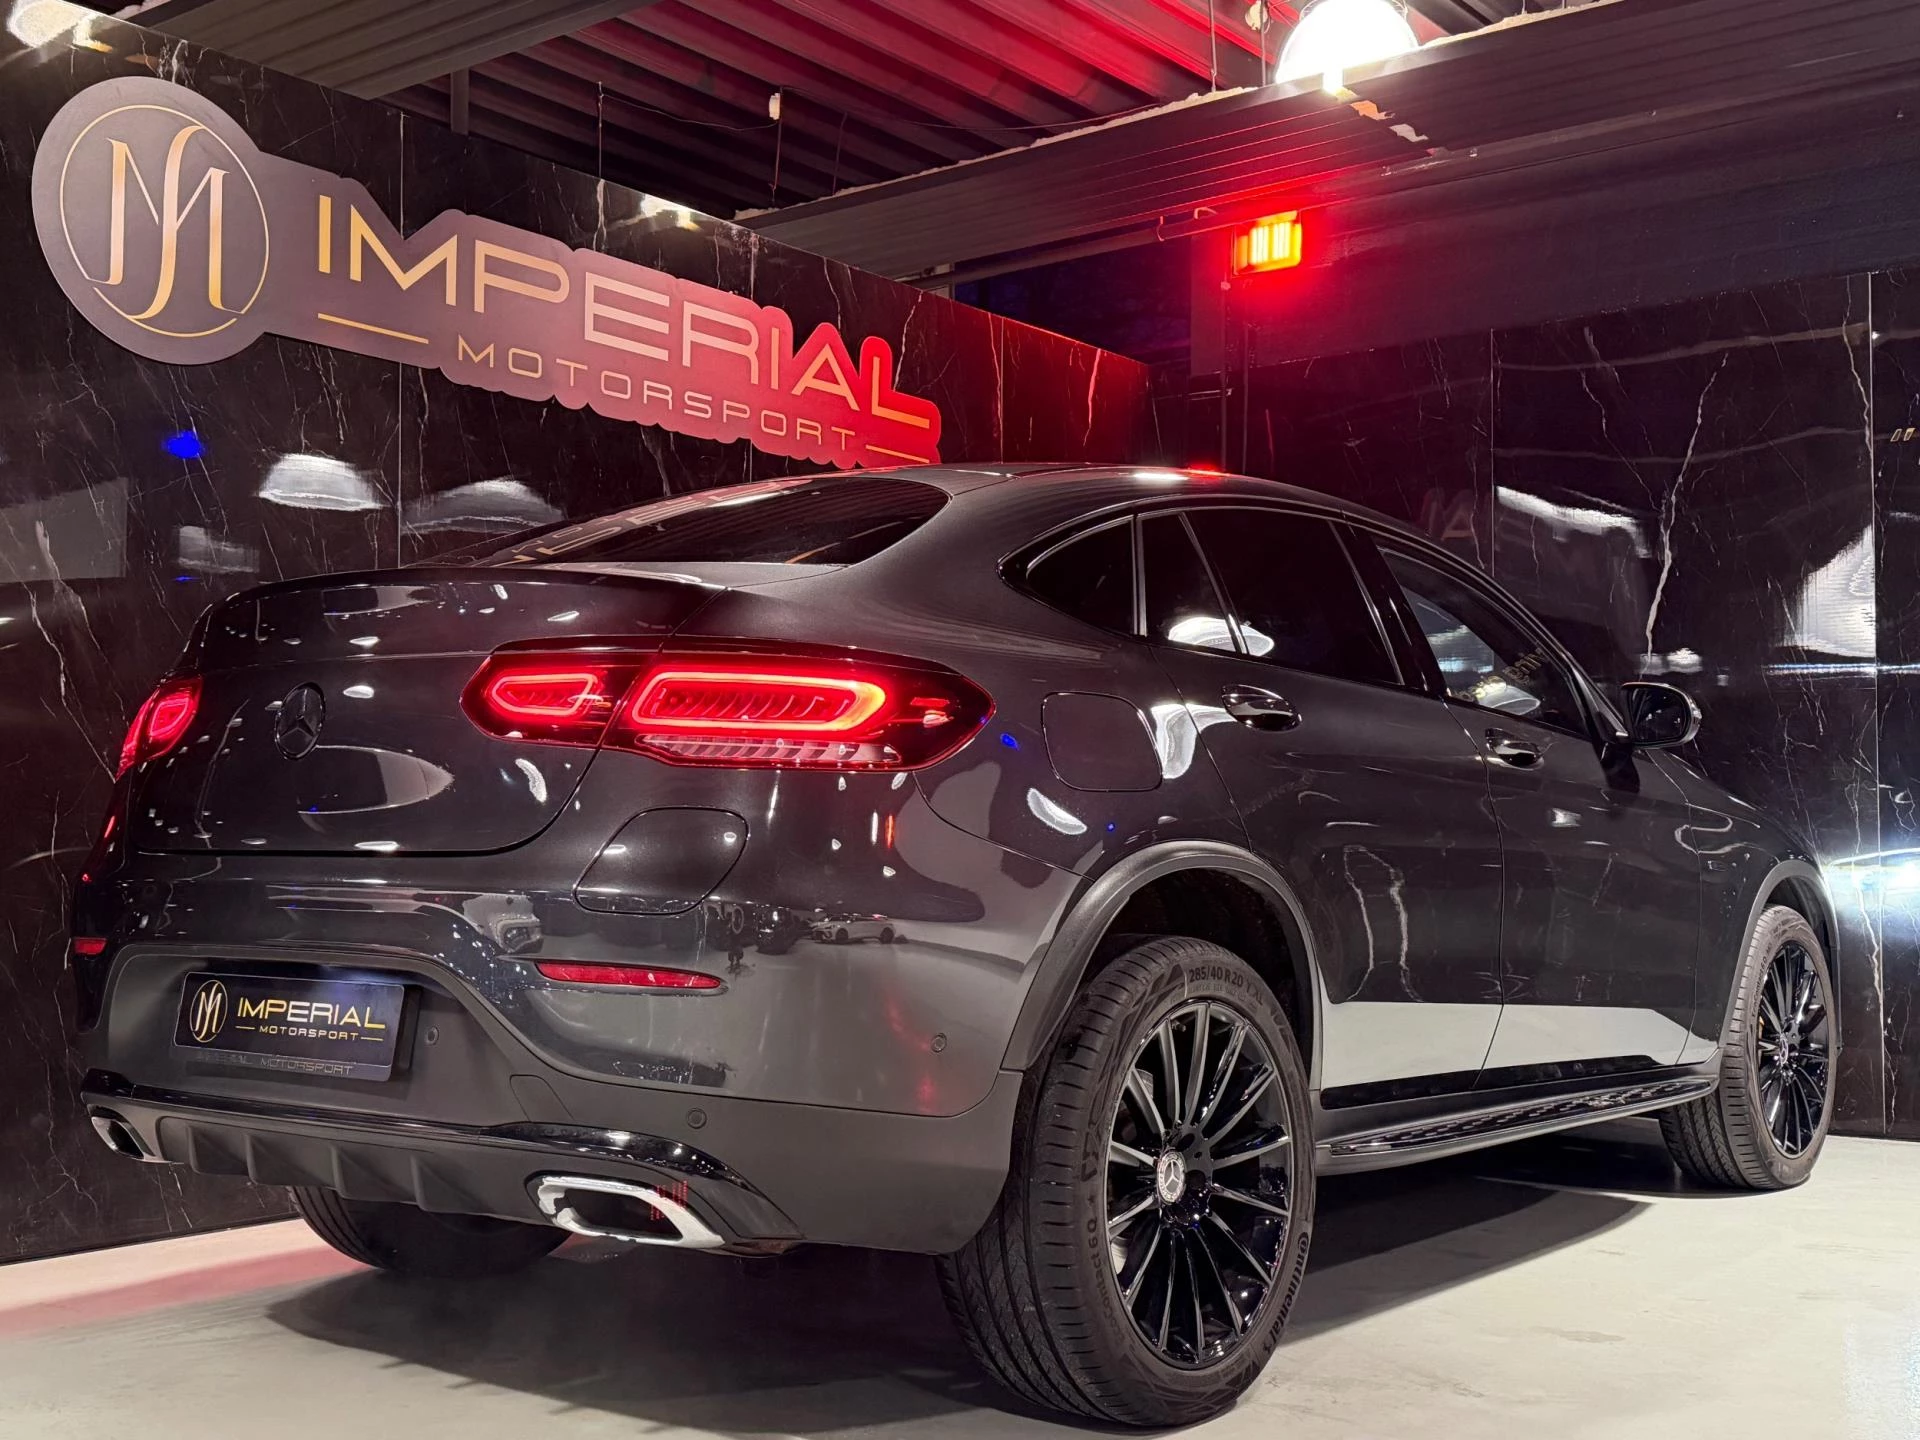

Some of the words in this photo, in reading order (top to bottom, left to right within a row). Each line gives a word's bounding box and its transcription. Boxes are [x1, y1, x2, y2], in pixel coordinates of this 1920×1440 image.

[317, 194, 931, 430] IMPERIAL
[458, 334, 856, 451] MOTORSPORT
[1189, 965, 1223, 982] 285/40
[237, 997, 386, 1030] IMPERIAL
[258, 1025, 360, 1042] MOTORSPORT
[260, 1057, 354, 1076] MOTORSPORT
[1270, 1231, 1309, 1344] Continental
